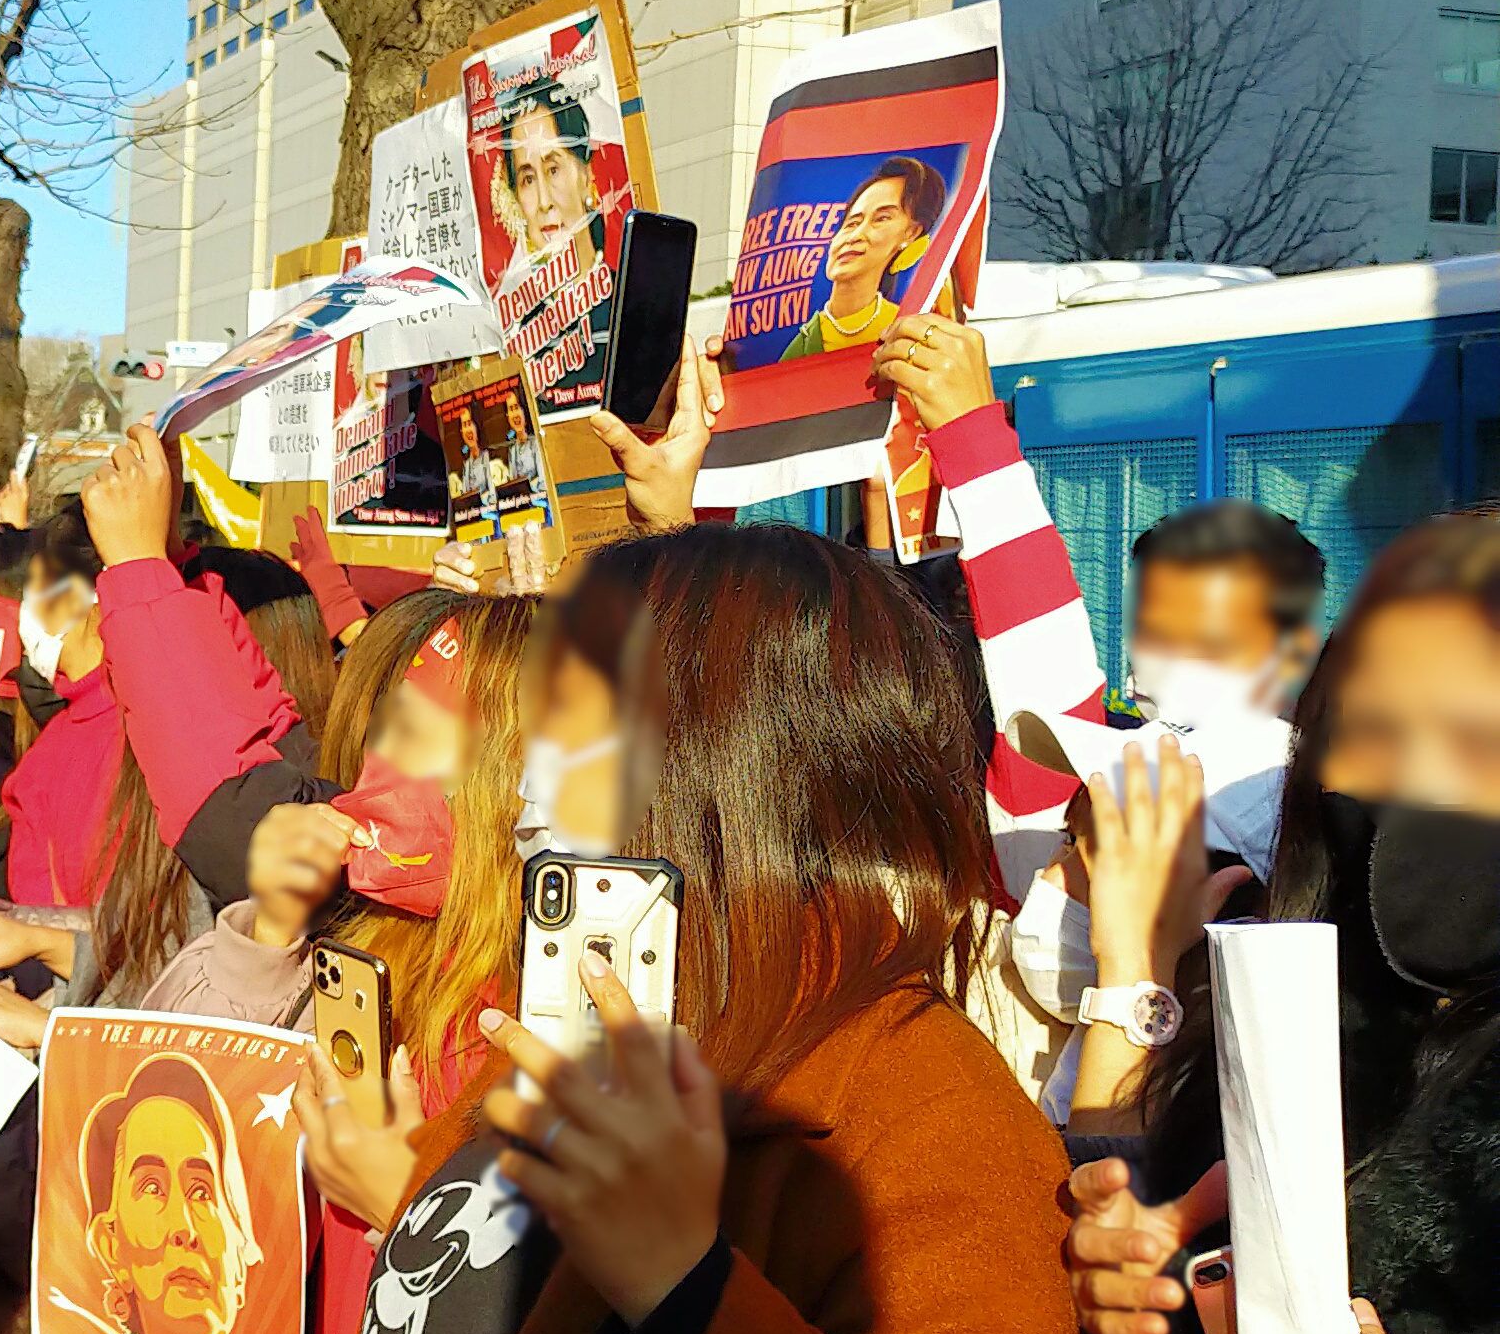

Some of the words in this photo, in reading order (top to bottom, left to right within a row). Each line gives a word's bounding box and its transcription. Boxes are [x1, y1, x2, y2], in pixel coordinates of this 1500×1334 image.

[380, 182, 463, 233] ミャンマー国軍が
[741, 208, 779, 254] REE
[774, 202, 848, 245] FREE
[498, 238, 578, 331] Demand
[759, 246, 825, 289] AUNG
[724, 302, 749, 342] AN
[750, 297, 777, 336] SU
[778, 286, 812, 330] KYI
[335, 396, 396, 455] Demand
[430, 629, 459, 659] NLD
[100, 1024, 133, 1044] THE
[139, 1026, 181, 1047] WAY
[185, 1030, 217, 1049] WE
[221, 1034, 291, 1064] TRUST
